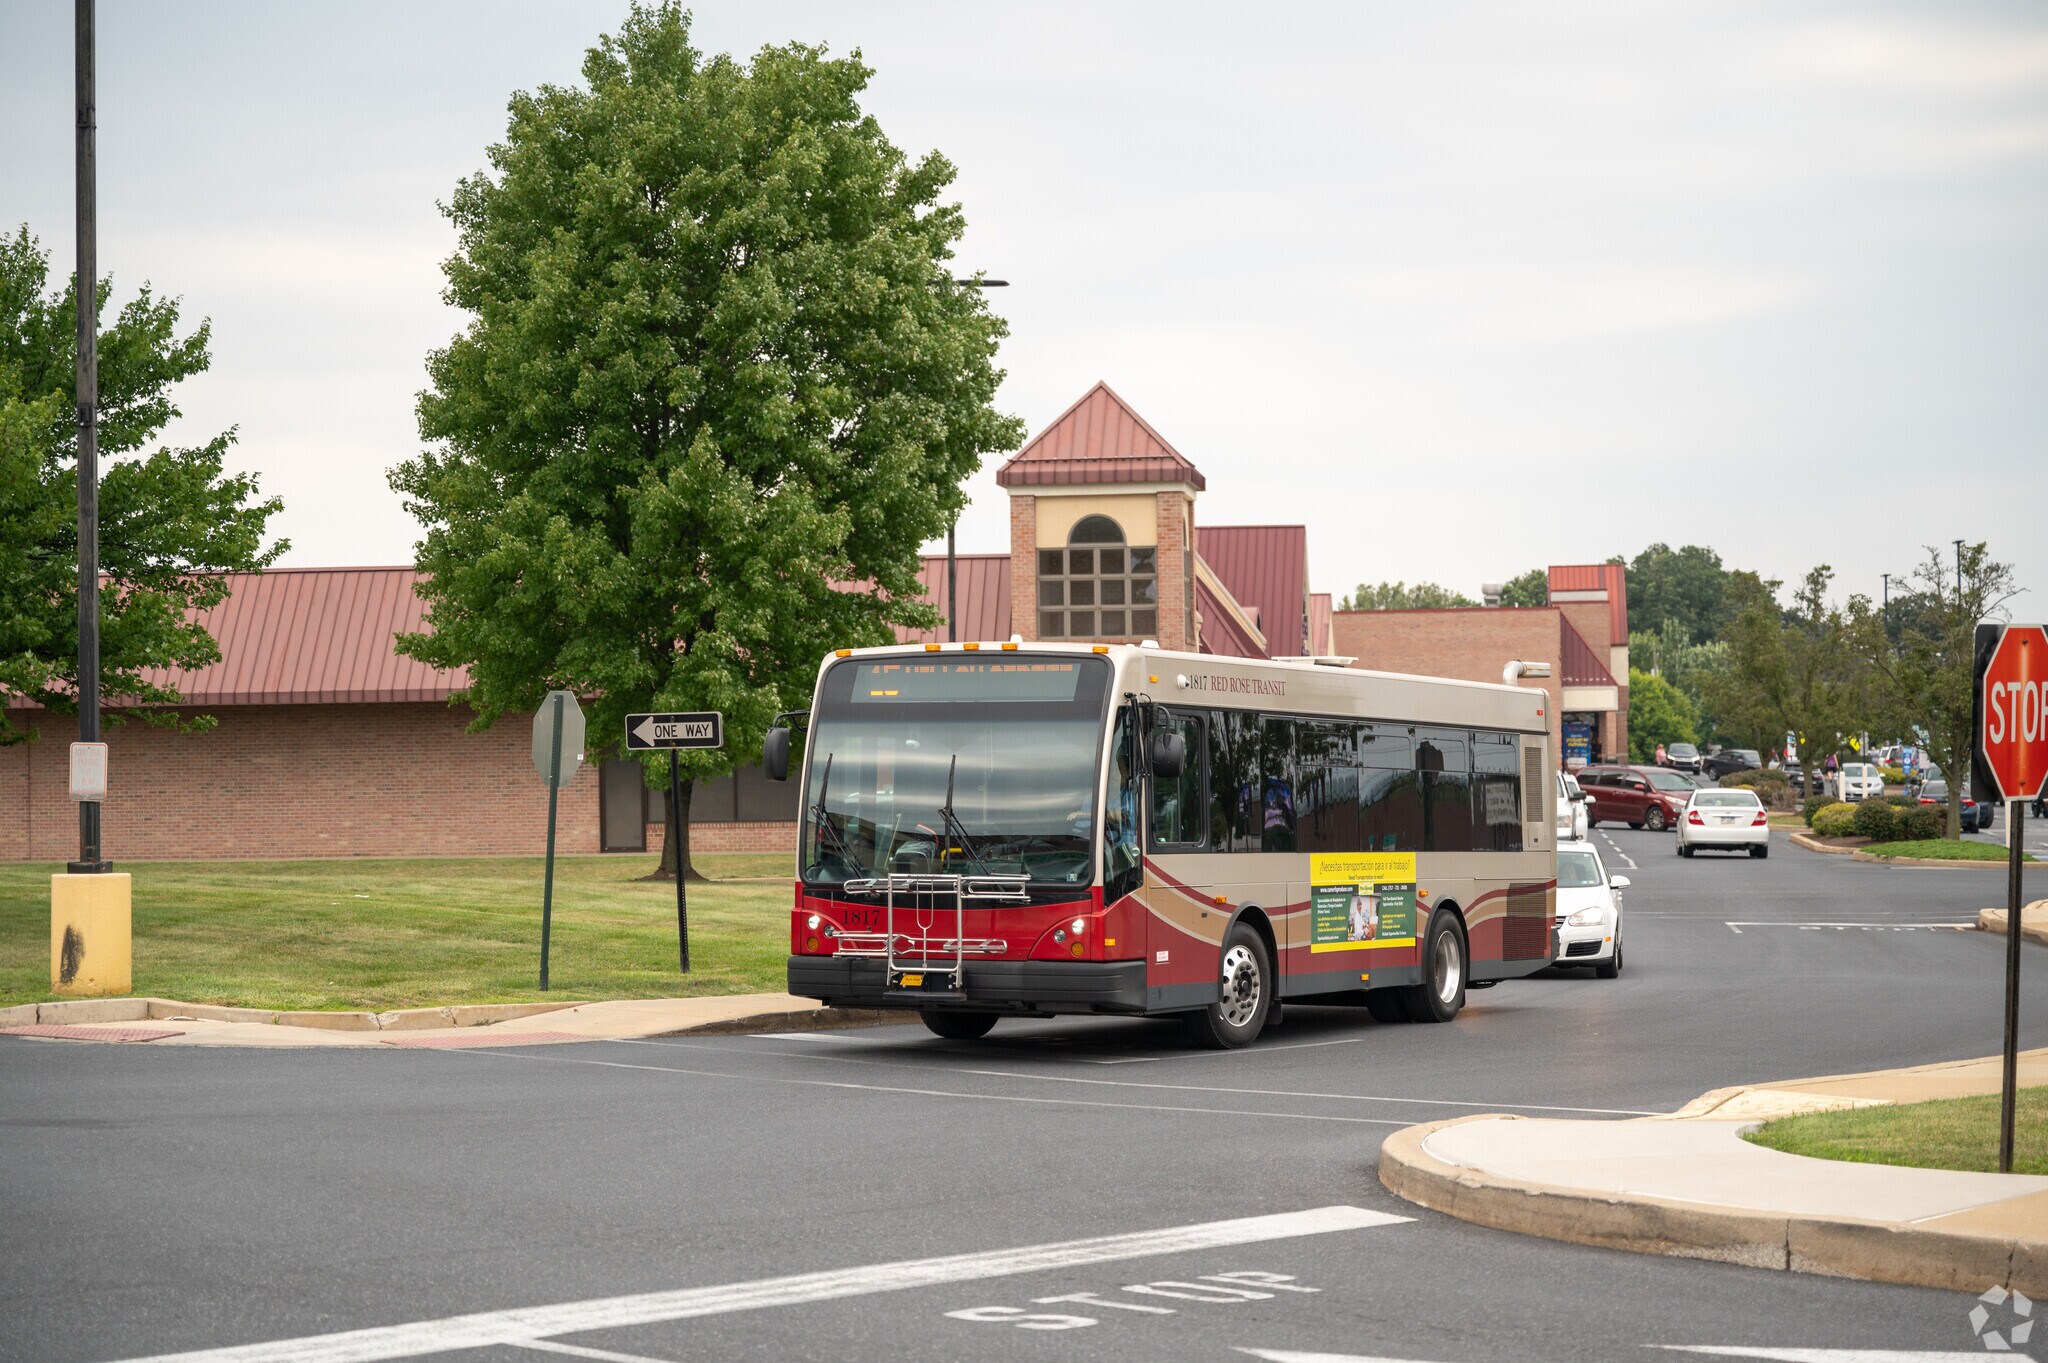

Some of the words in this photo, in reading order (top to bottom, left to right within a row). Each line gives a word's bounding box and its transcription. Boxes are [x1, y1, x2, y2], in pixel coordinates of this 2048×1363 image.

[1190, 675, 1207, 690] 1817
[1211, 675, 1228, 691] RED
[1230, 677, 1250, 693] ROSE
[1252, 679, 1286, 696] TRANSIT
[654, 724, 678, 738] ONE
[685, 724, 710, 737] WAY
[1319, 861, 1343, 874] ¿Necesitas
[1342, 860, 1374, 873] transportación
[1374, 861, 1384, 873] para
[1393, 859, 1411, 872] trabajo?
[843, 908, 881, 926] 1817
[943, 1271, 1322, 1330] STOP
